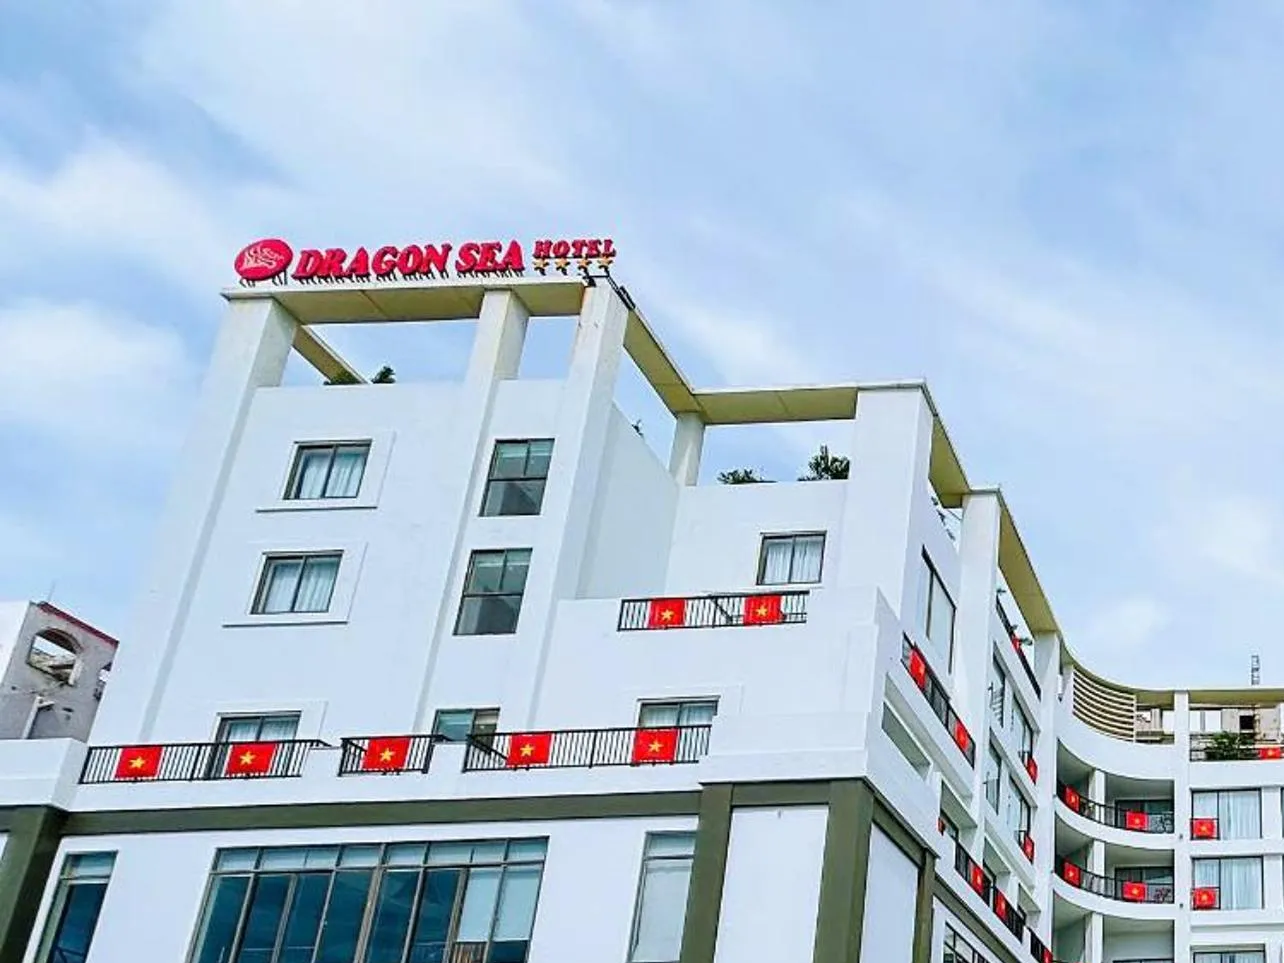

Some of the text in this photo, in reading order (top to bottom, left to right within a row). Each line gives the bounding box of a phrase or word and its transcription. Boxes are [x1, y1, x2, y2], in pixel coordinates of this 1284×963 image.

[291, 239, 617, 280] DRAGON SEA HOTEL
